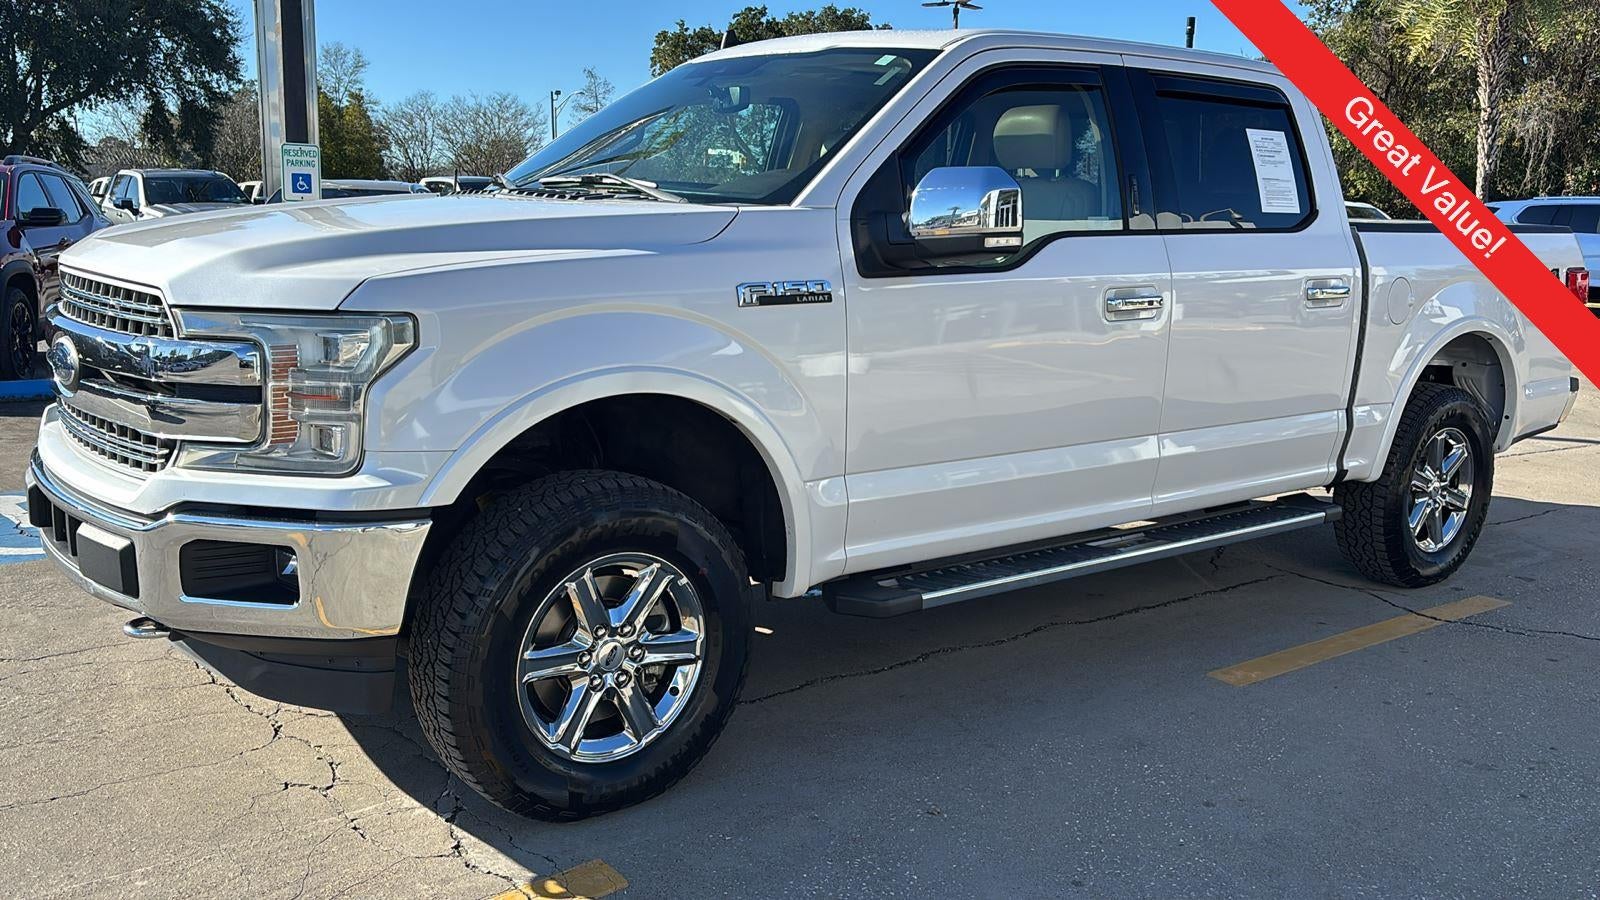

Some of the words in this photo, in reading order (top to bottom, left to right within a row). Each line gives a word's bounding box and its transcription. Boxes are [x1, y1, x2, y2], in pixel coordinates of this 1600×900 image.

[283, 149, 317, 158] RESERVED
[286, 159, 316, 168] PARKING
[796, 295, 830, 303] LARIAT
